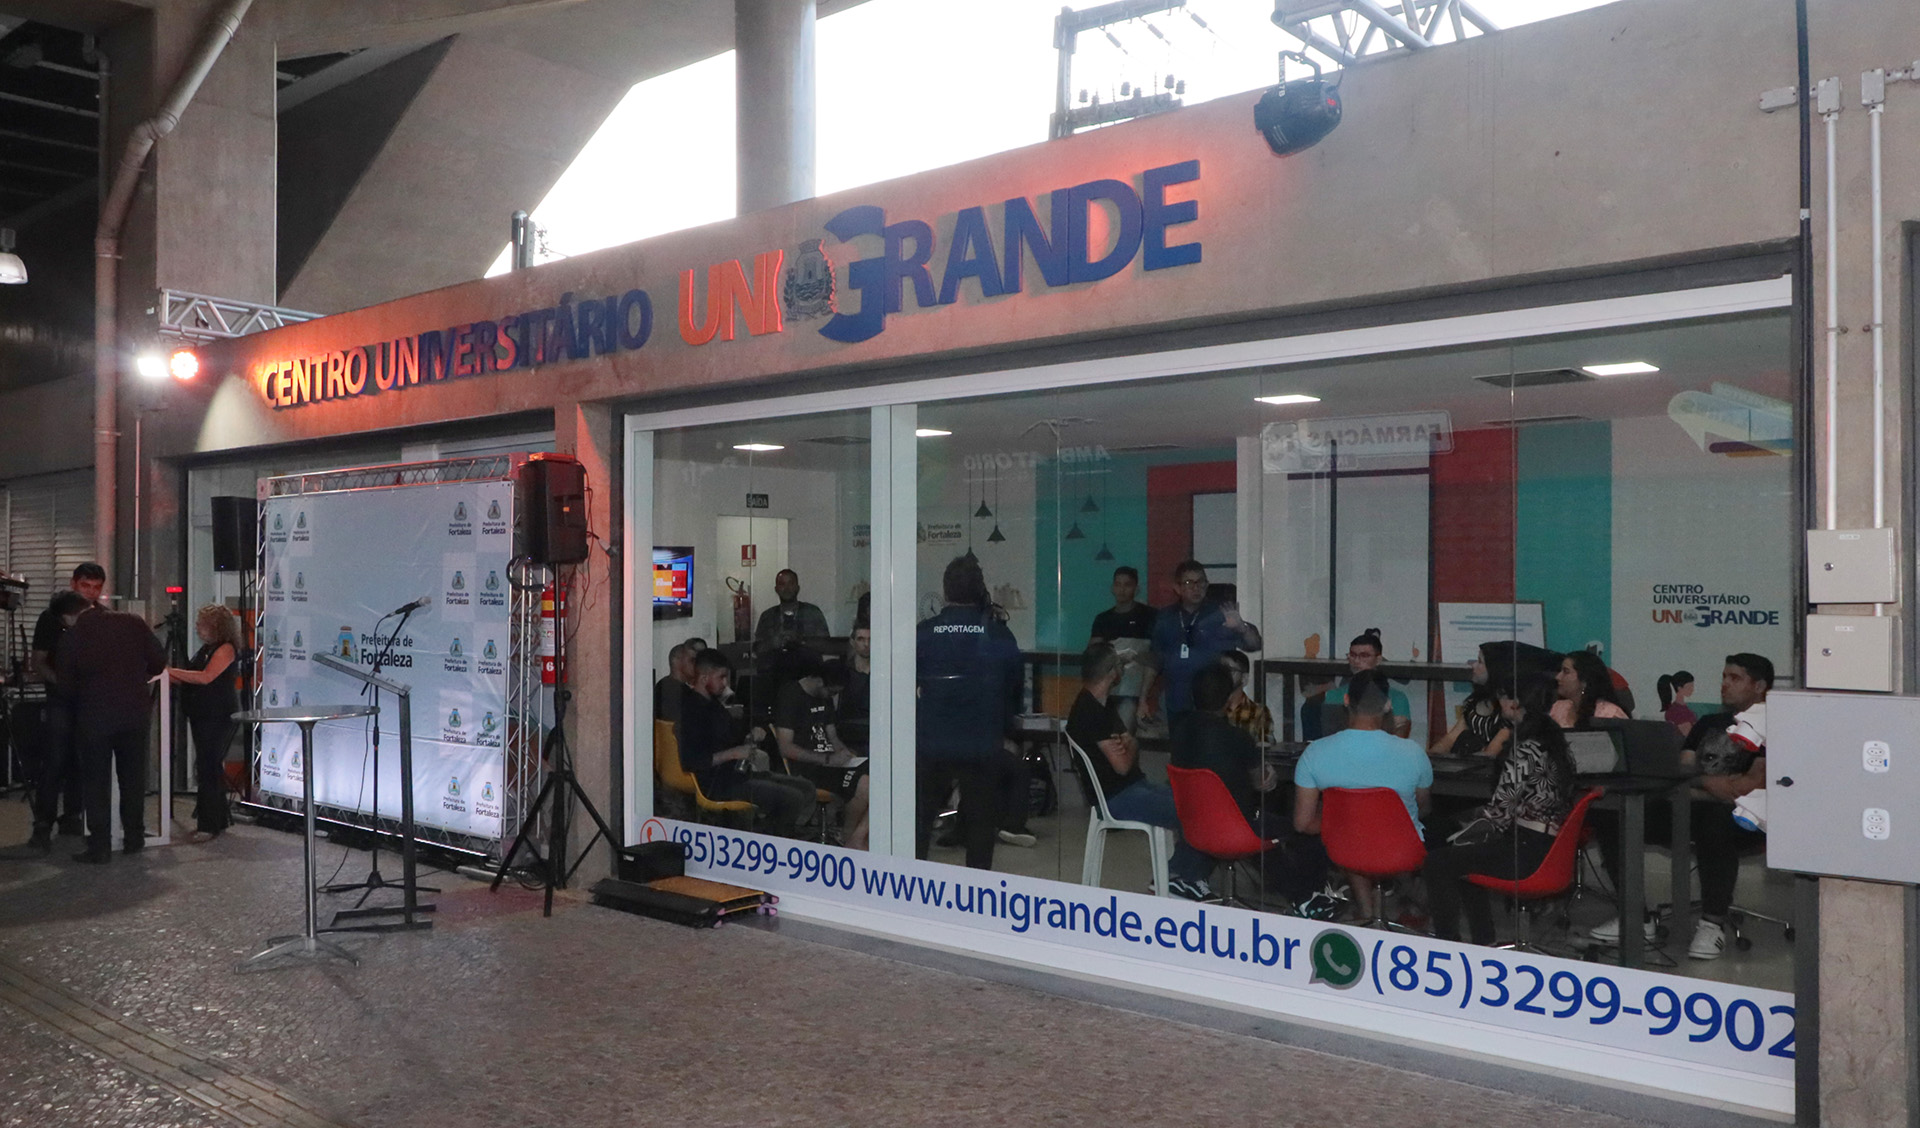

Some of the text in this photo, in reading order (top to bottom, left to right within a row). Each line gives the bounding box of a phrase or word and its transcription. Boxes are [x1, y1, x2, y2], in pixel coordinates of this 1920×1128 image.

[260, 288, 653, 408] CENTRO UNIVERSITÁRIO
[448, 528, 472, 536] Fortaleza
[482, 527, 506, 535] Fortaleza
[928, 530, 962, 540] Fortaleza
[1653, 584, 1704, 594] CENTRO
[446, 597, 469, 606] Fortaleza
[479, 598, 504, 606] Fortaleza
[1653, 594, 1750, 605] UNIVERSITÁRIO
[933, 625, 985, 634] REPORTAGEM
[361, 633, 413, 648] Prefeitura de
[361, 648, 413, 668] Fortaleza
[444, 665, 467, 673] Fortaleza
[478, 667, 502, 675] Fortaleza
[443, 735, 467, 744] Fortaleza
[477, 738, 501, 748] Fortaleza
[443, 802, 466, 813] Fortaleza
[475, 807, 500, 819] Fortaleza
[862, 867, 1301, 970] www.unigrande.edu.br
[1371, 940, 1796, 1059] (85)3299-9902
